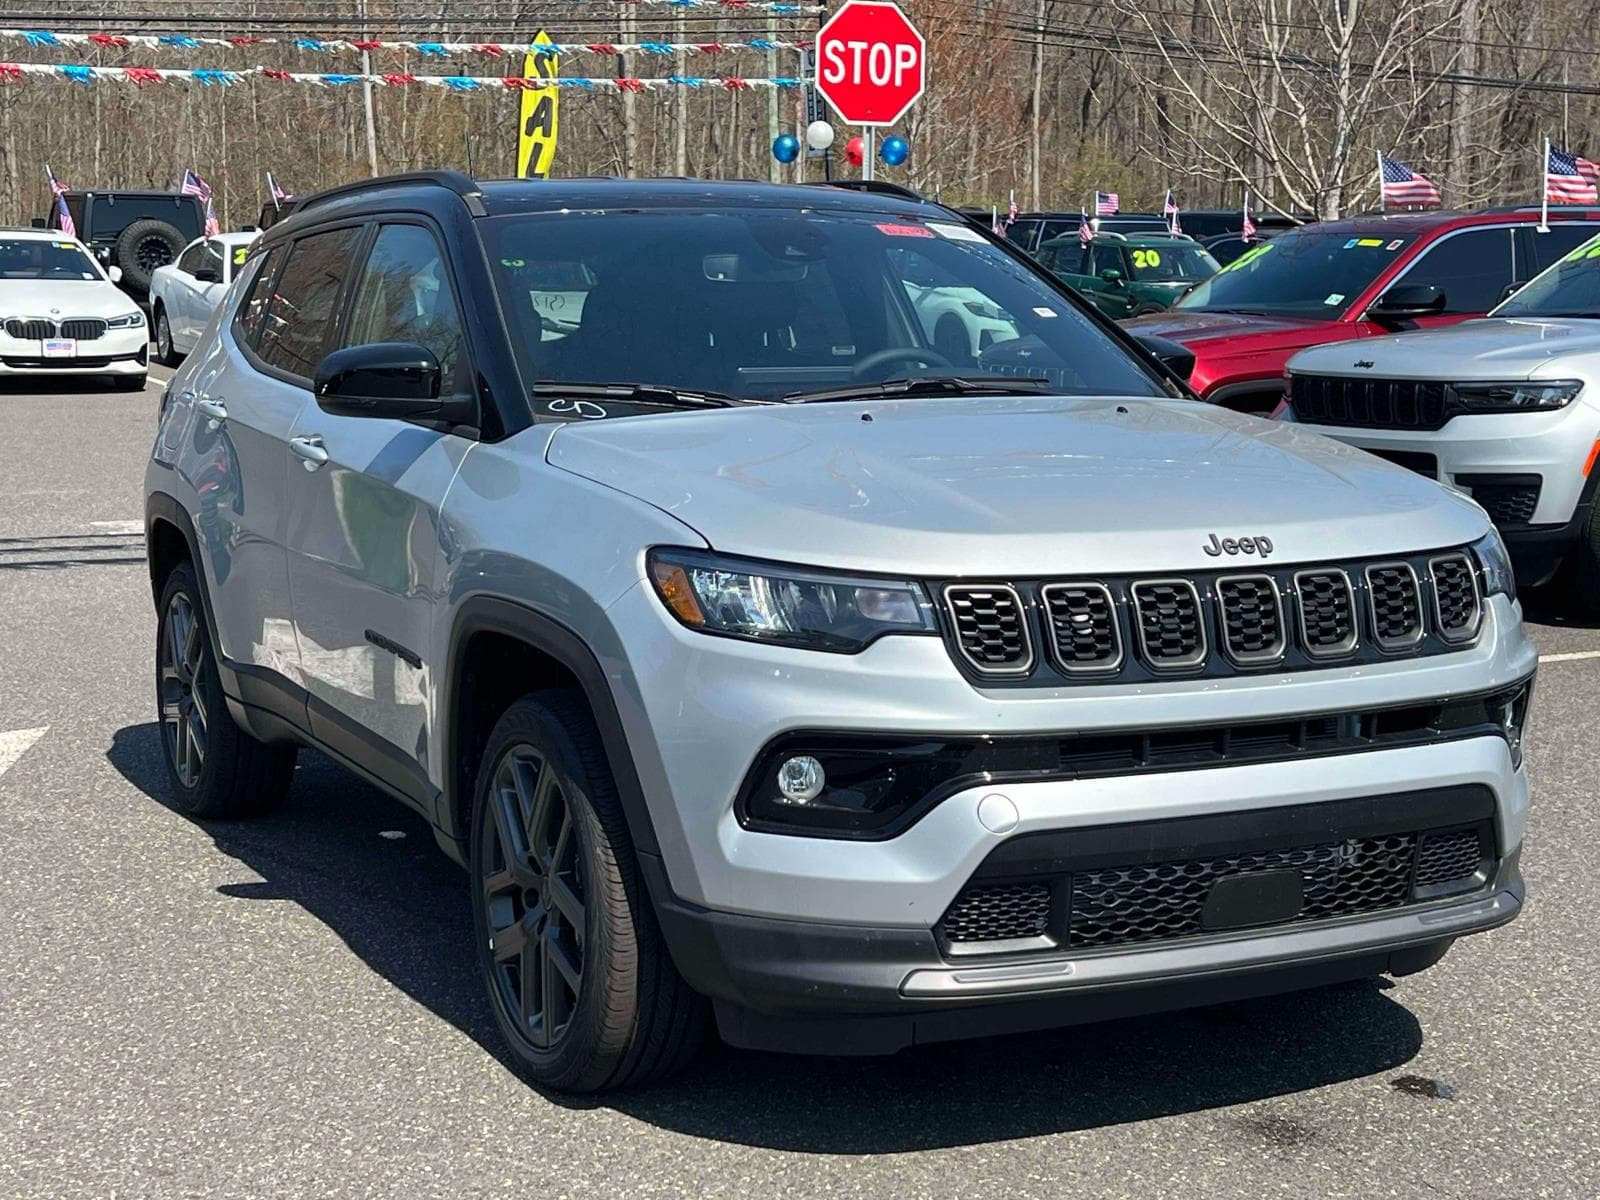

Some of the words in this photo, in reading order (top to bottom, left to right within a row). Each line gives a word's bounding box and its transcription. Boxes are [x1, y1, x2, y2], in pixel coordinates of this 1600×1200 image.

[823, 39, 918, 87] STOP
[1133, 250, 1161, 267] 20
[1202, 533, 1274, 558] Jeep
